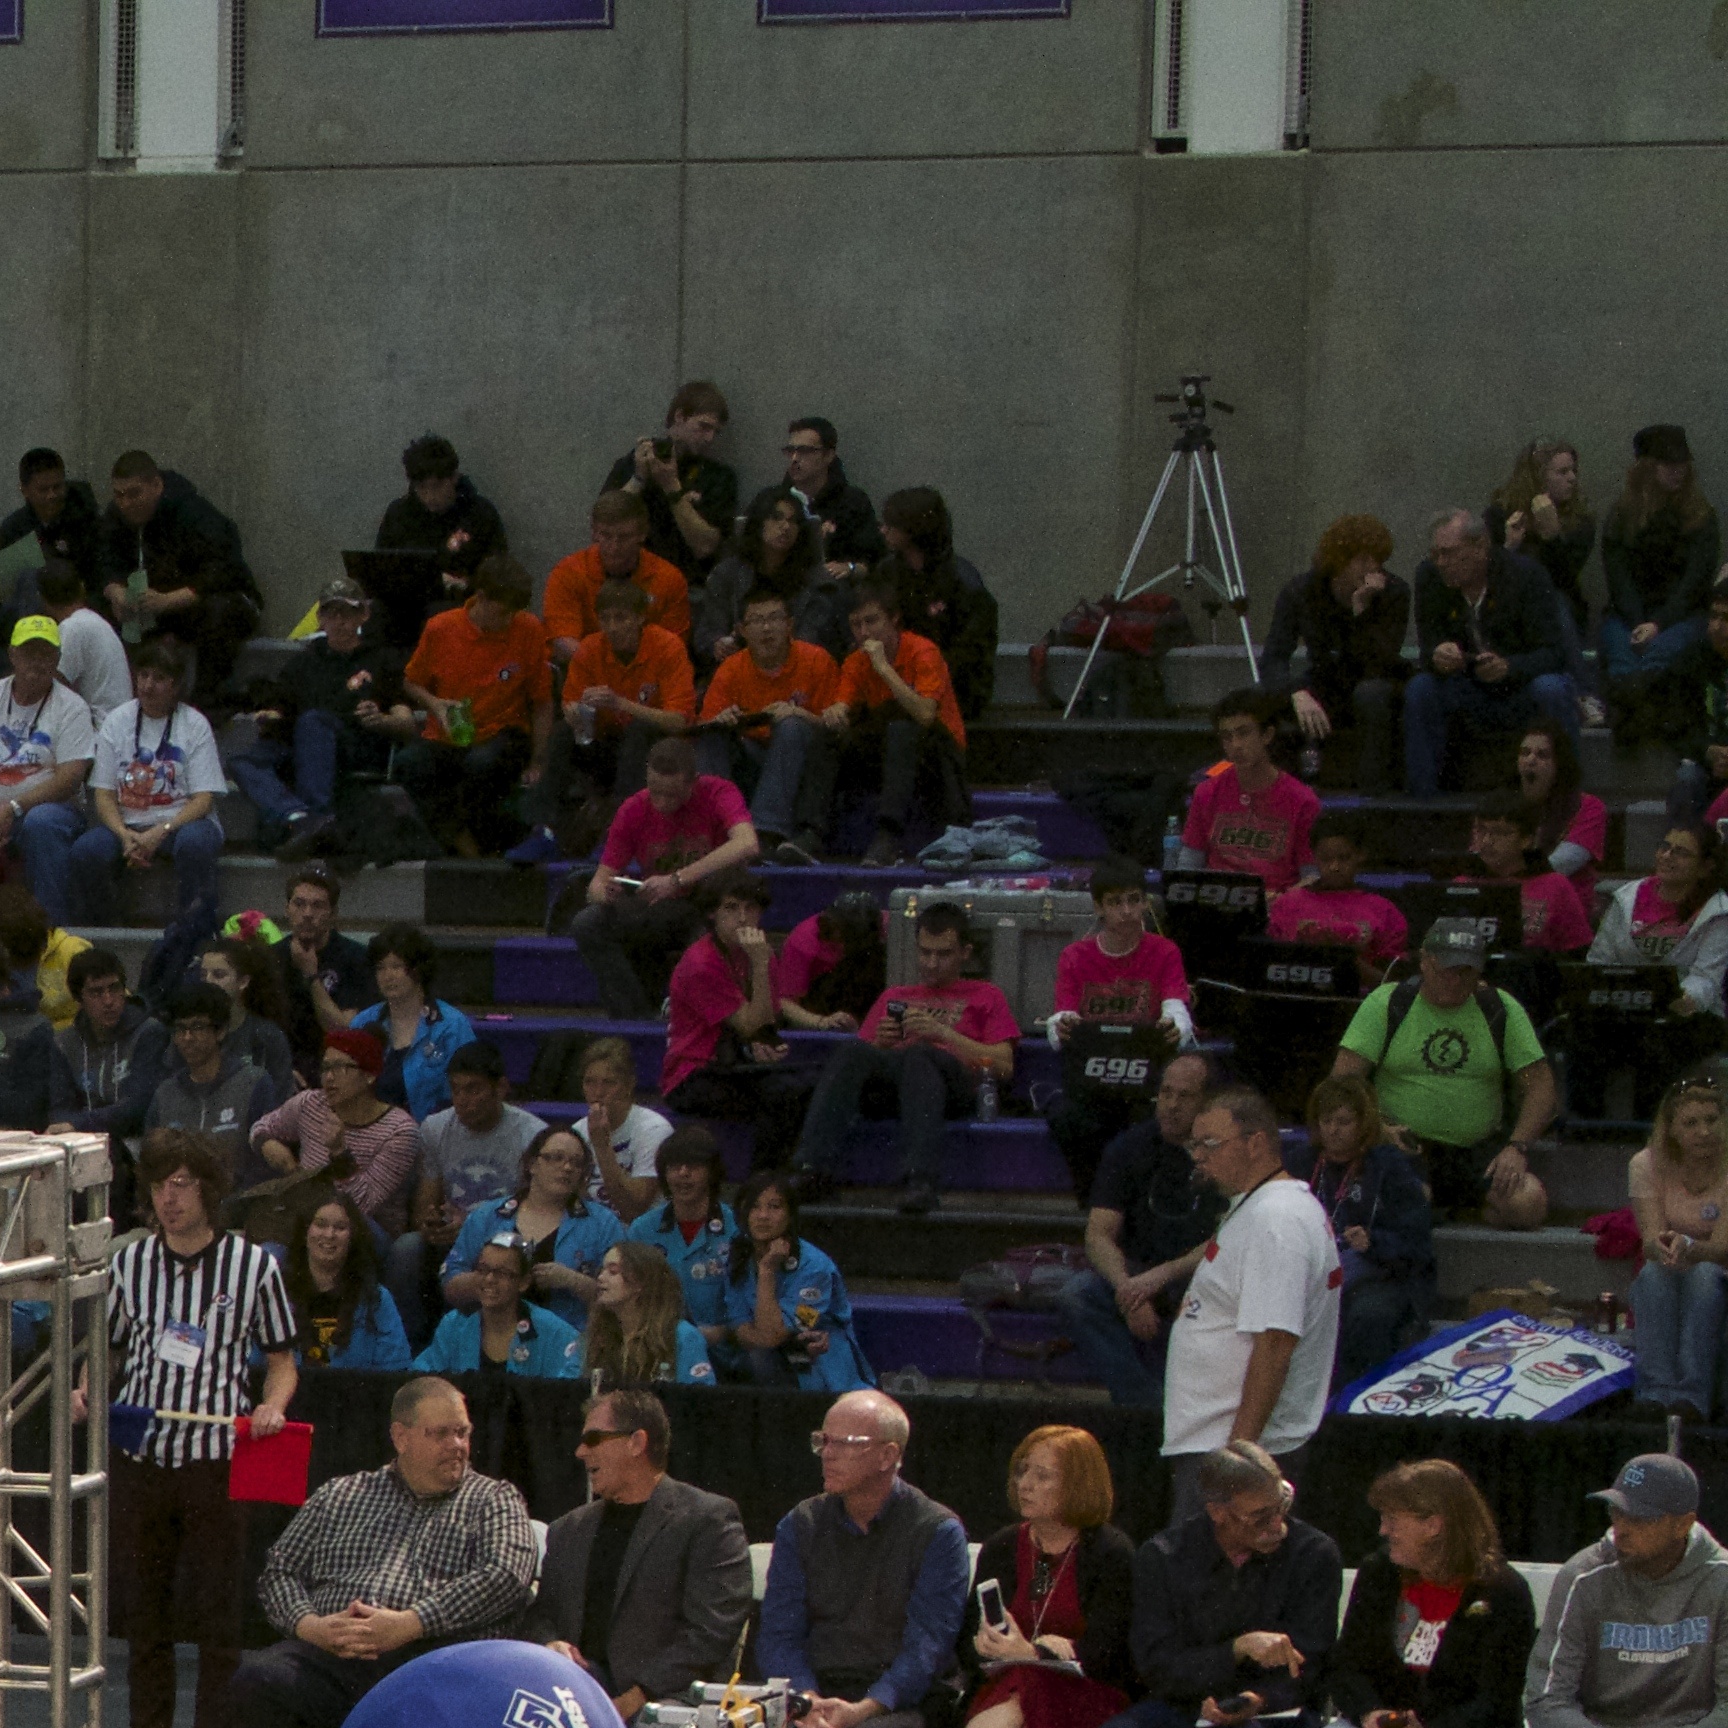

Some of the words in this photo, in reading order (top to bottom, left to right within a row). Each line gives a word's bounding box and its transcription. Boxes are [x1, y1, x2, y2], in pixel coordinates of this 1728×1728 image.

[1166, 882, 1260, 906] 696
[1266, 964, 1334, 986] 696
[1084, 1056, 1150, 1079] 696
[1600, 1616, 1709, 1652] BRONCOS
